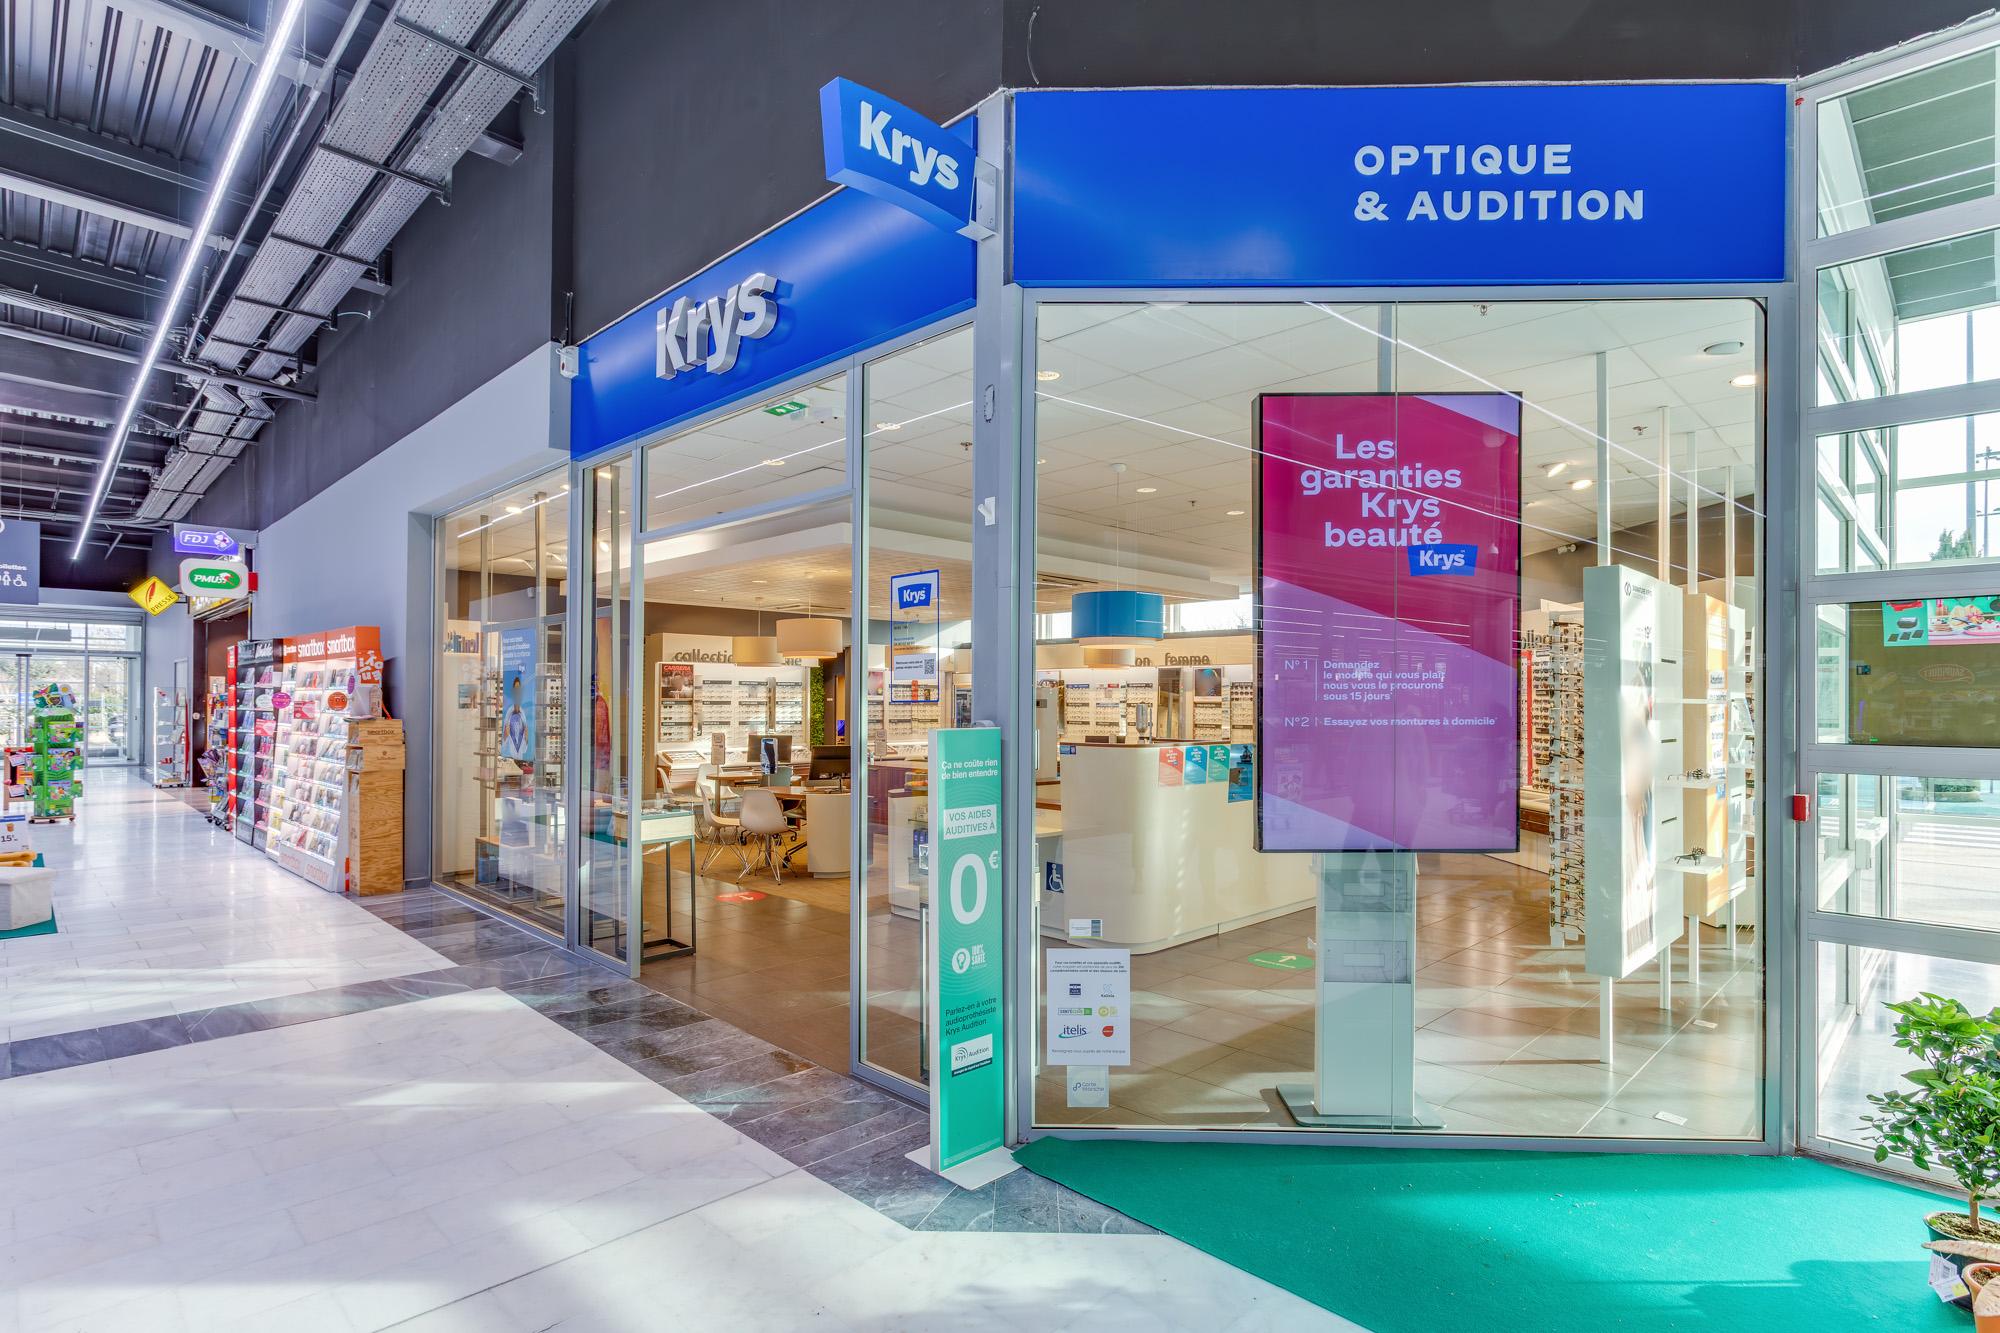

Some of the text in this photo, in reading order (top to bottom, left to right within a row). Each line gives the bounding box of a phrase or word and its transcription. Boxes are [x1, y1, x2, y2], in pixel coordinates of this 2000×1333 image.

[860, 101, 959, 190] Krys
[1354, 144, 1572, 175] OPTIQUE
[1354, 189, 1644, 221] & AUDITION
[656, 272, 778, 380] Krys
[1336, 434, 1395, 460] Les
[1300, 463, 1462, 495] garanties
[1361, 492, 1440, 524] Krys
[184, 534, 208, 544] FDJ
[1324, 522, 1443, 547] beauté
[1419, 550, 1465, 570] Krys
[194, 574, 218, 583] PMU
[150, 593, 175, 612] PRESSE
[903, 589, 925, 604] Krys
[297, 638, 325, 658] smartbox
[327, 633, 355, 654] smartbox
[1165, 653, 1210, 666] femme
[1323, 660, 1380, 670] Demandez
[1323, 671, 1332, 679] le
[1375, 671, 1392, 682] qui
[1378, 681, 1387, 690] le
[1390, 682, 1444, 692] procurons
[1350, 692, 1362, 700] 15
[1323, 717, 1367, 727] Essayez
[1390, 718, 1440, 726] montures
[1442, 716, 1449, 726] à
[941, 758, 998, 771] Ça ne coûte rien
[941, 768, 998, 780] de bien entendre
[949, 808, 992, 822] VOS AIDES
[945, 822, 988, 836] AUDITIVES
[950, 850, 999, 925] 0 €
[945, 1001, 975, 1017] Parlez-en
[981, 997, 997, 1006] votre
[945, 1006, 997, 1027] audioprothésiste
[945, 1018, 987, 1036] Krys Audition
[1063, 1024, 1087, 1036] itelis
[969, 1046, 990, 1057] Audition
